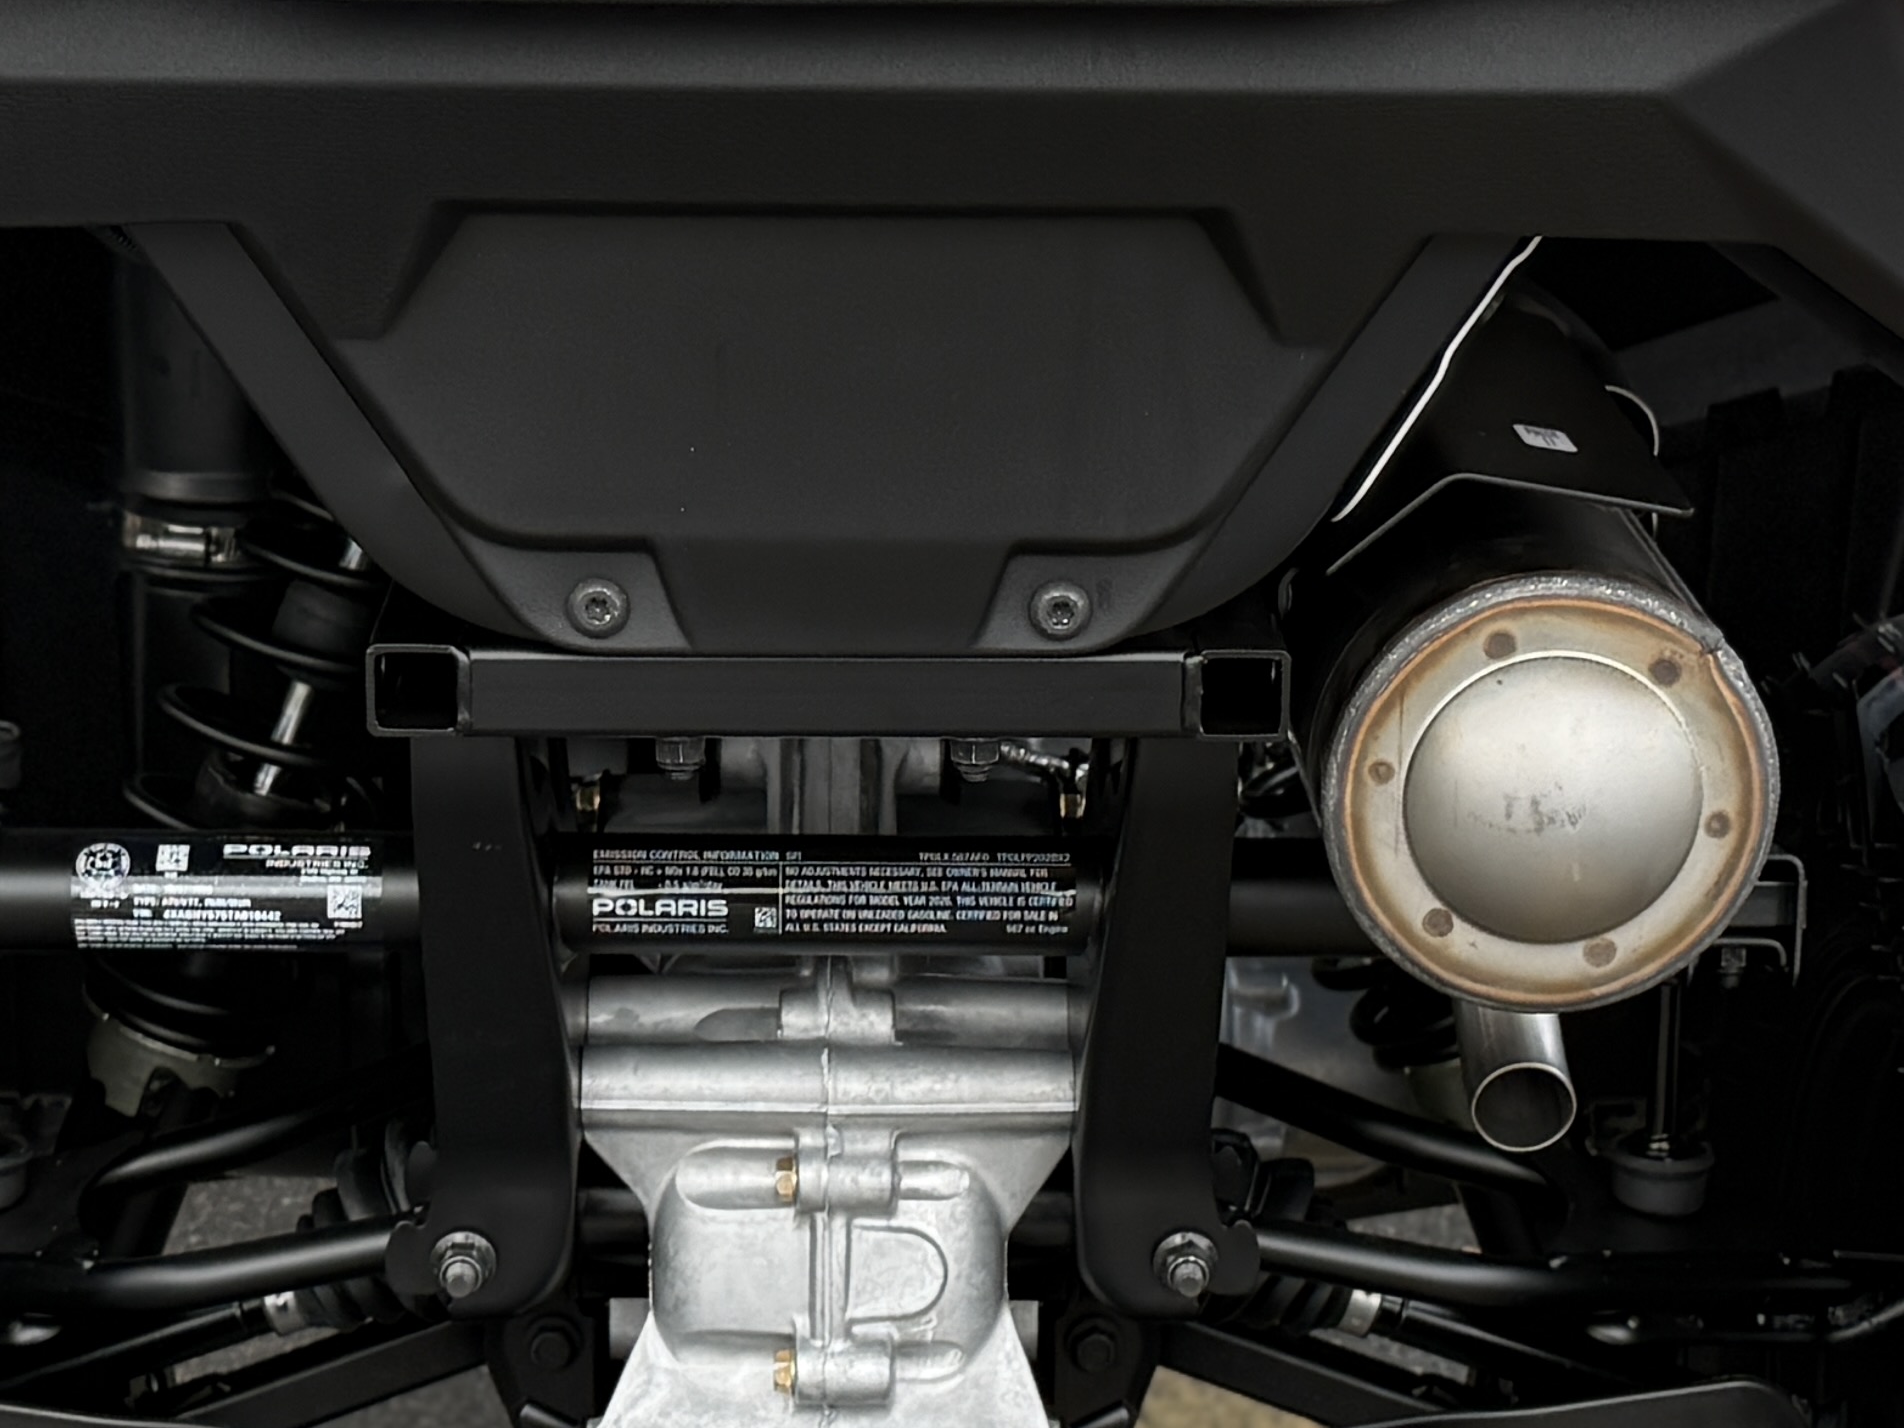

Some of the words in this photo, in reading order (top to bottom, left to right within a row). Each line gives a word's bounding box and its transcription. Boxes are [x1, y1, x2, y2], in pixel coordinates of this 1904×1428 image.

[222, 843, 372, 857] POLARIS
[593, 848, 647, 860] EMISSION
[649, 849, 700, 860] CONTROL
[703, 850, 780, 861] INFORMATION
[265, 858, 341, 869] INDUSTRIES
[593, 865, 612, 876] EPA
[801, 866, 867, 877] ADJUSTMENTS
[926, 867, 943, 878] SEE
[989, 868, 1027, 878] MANUAL
[941, 881, 959, 892] EPA
[785, 894, 847, 905] REGULATIONS
[848, 894, 867, 905] FOR
[869, 895, 900, 906] MODEL
[903, 895, 926, 906] YEAR
[956, 896, 976, 907] THIS
[978, 896, 1014, 907] VEHICLE
[592, 898, 729, 916] POLARIS
[785, 908, 798, 919] TO
[799, 908, 841, 919] OPERATE
[858, 909, 905, 920] UNLEADED
[1003, 910, 1022, 921] FOR
[1023, 910, 1046, 921] SALE
[1047, 910, 1059, 921] IN
[592, 923, 640, 933] POLARIS
[641, 923, 706, 934] INDUSTRIES
[707, 924, 729, 933] INC.
[784, 922, 800, 932] ALL
[822, 923, 857, 933] STATES
[858, 923, 892, 933] EXCEPT
[1038, 924, 1069, 935] Engine
